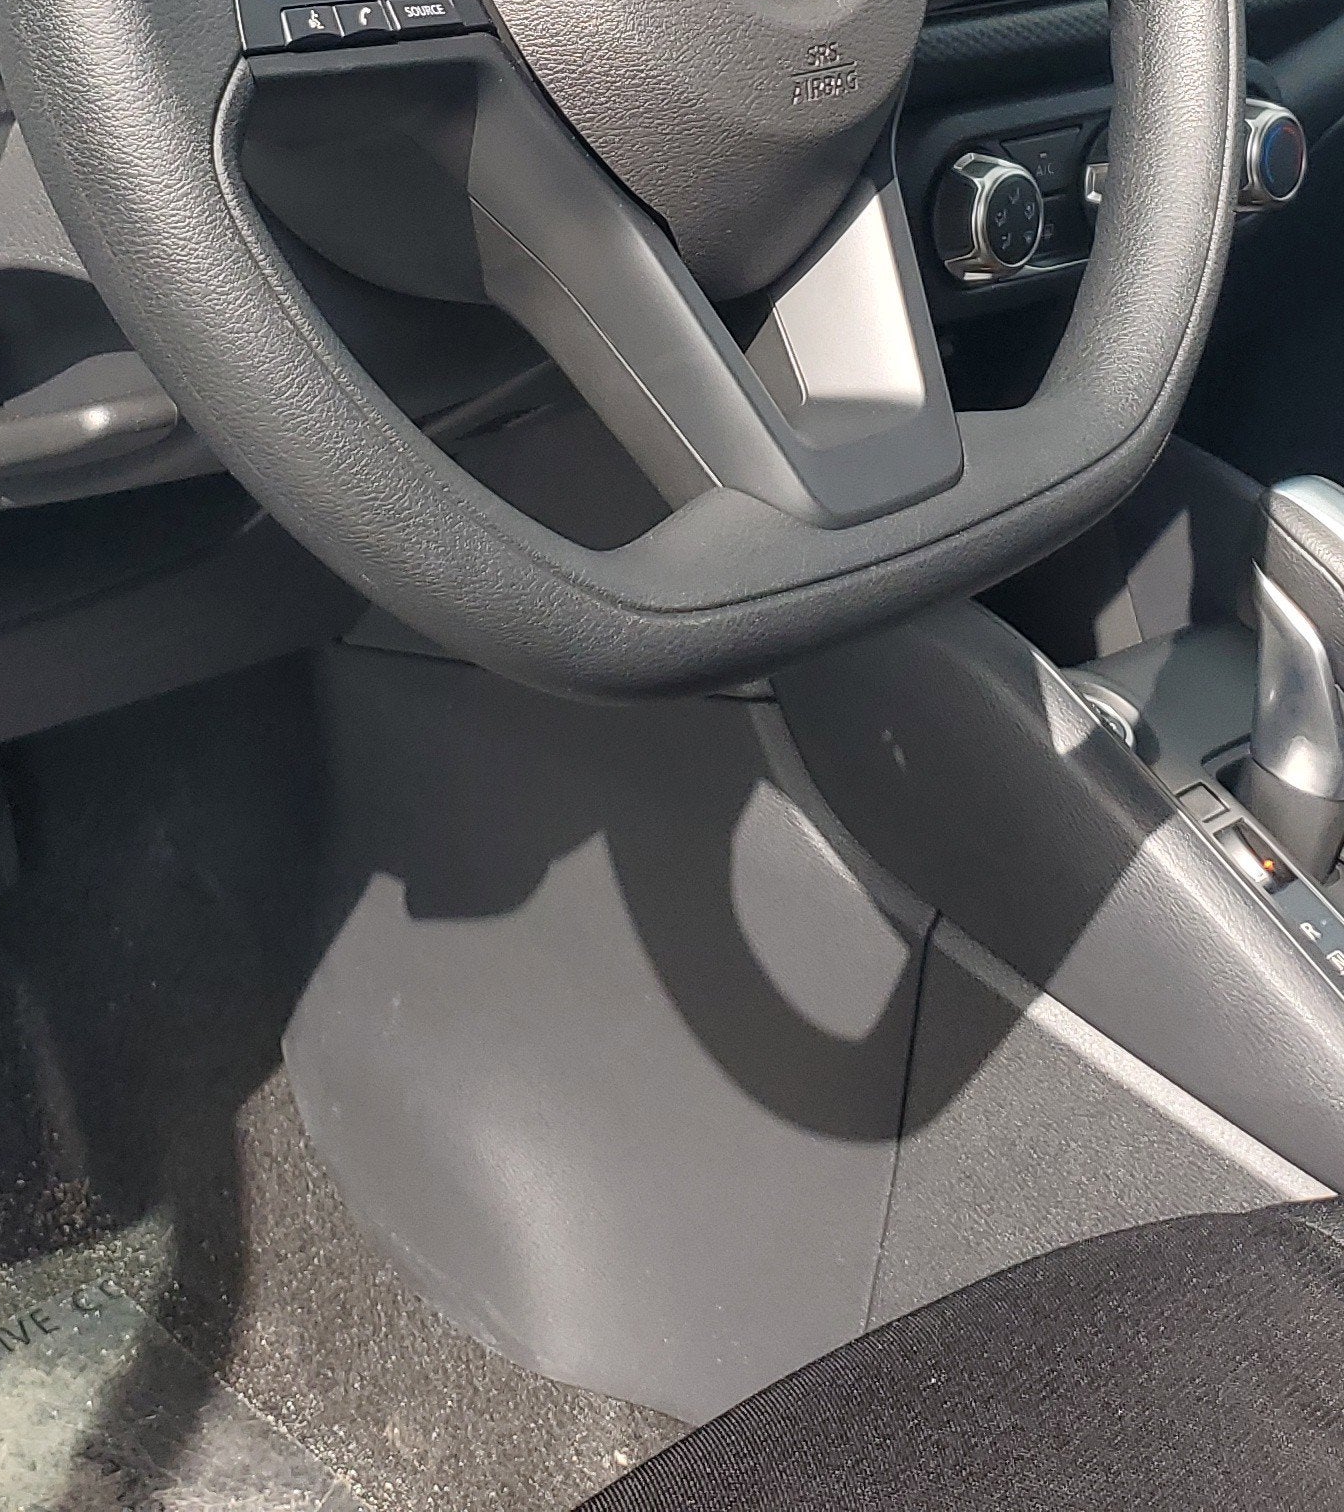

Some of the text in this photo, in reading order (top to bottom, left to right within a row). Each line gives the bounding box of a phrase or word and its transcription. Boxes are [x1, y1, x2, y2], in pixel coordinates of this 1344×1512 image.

[404, 3, 446, 18] SOURCE
[806, 41, 840, 66] SRS
[791, 69, 859, 105] AIRBAG
[1299, 921, 1322, 942] R
